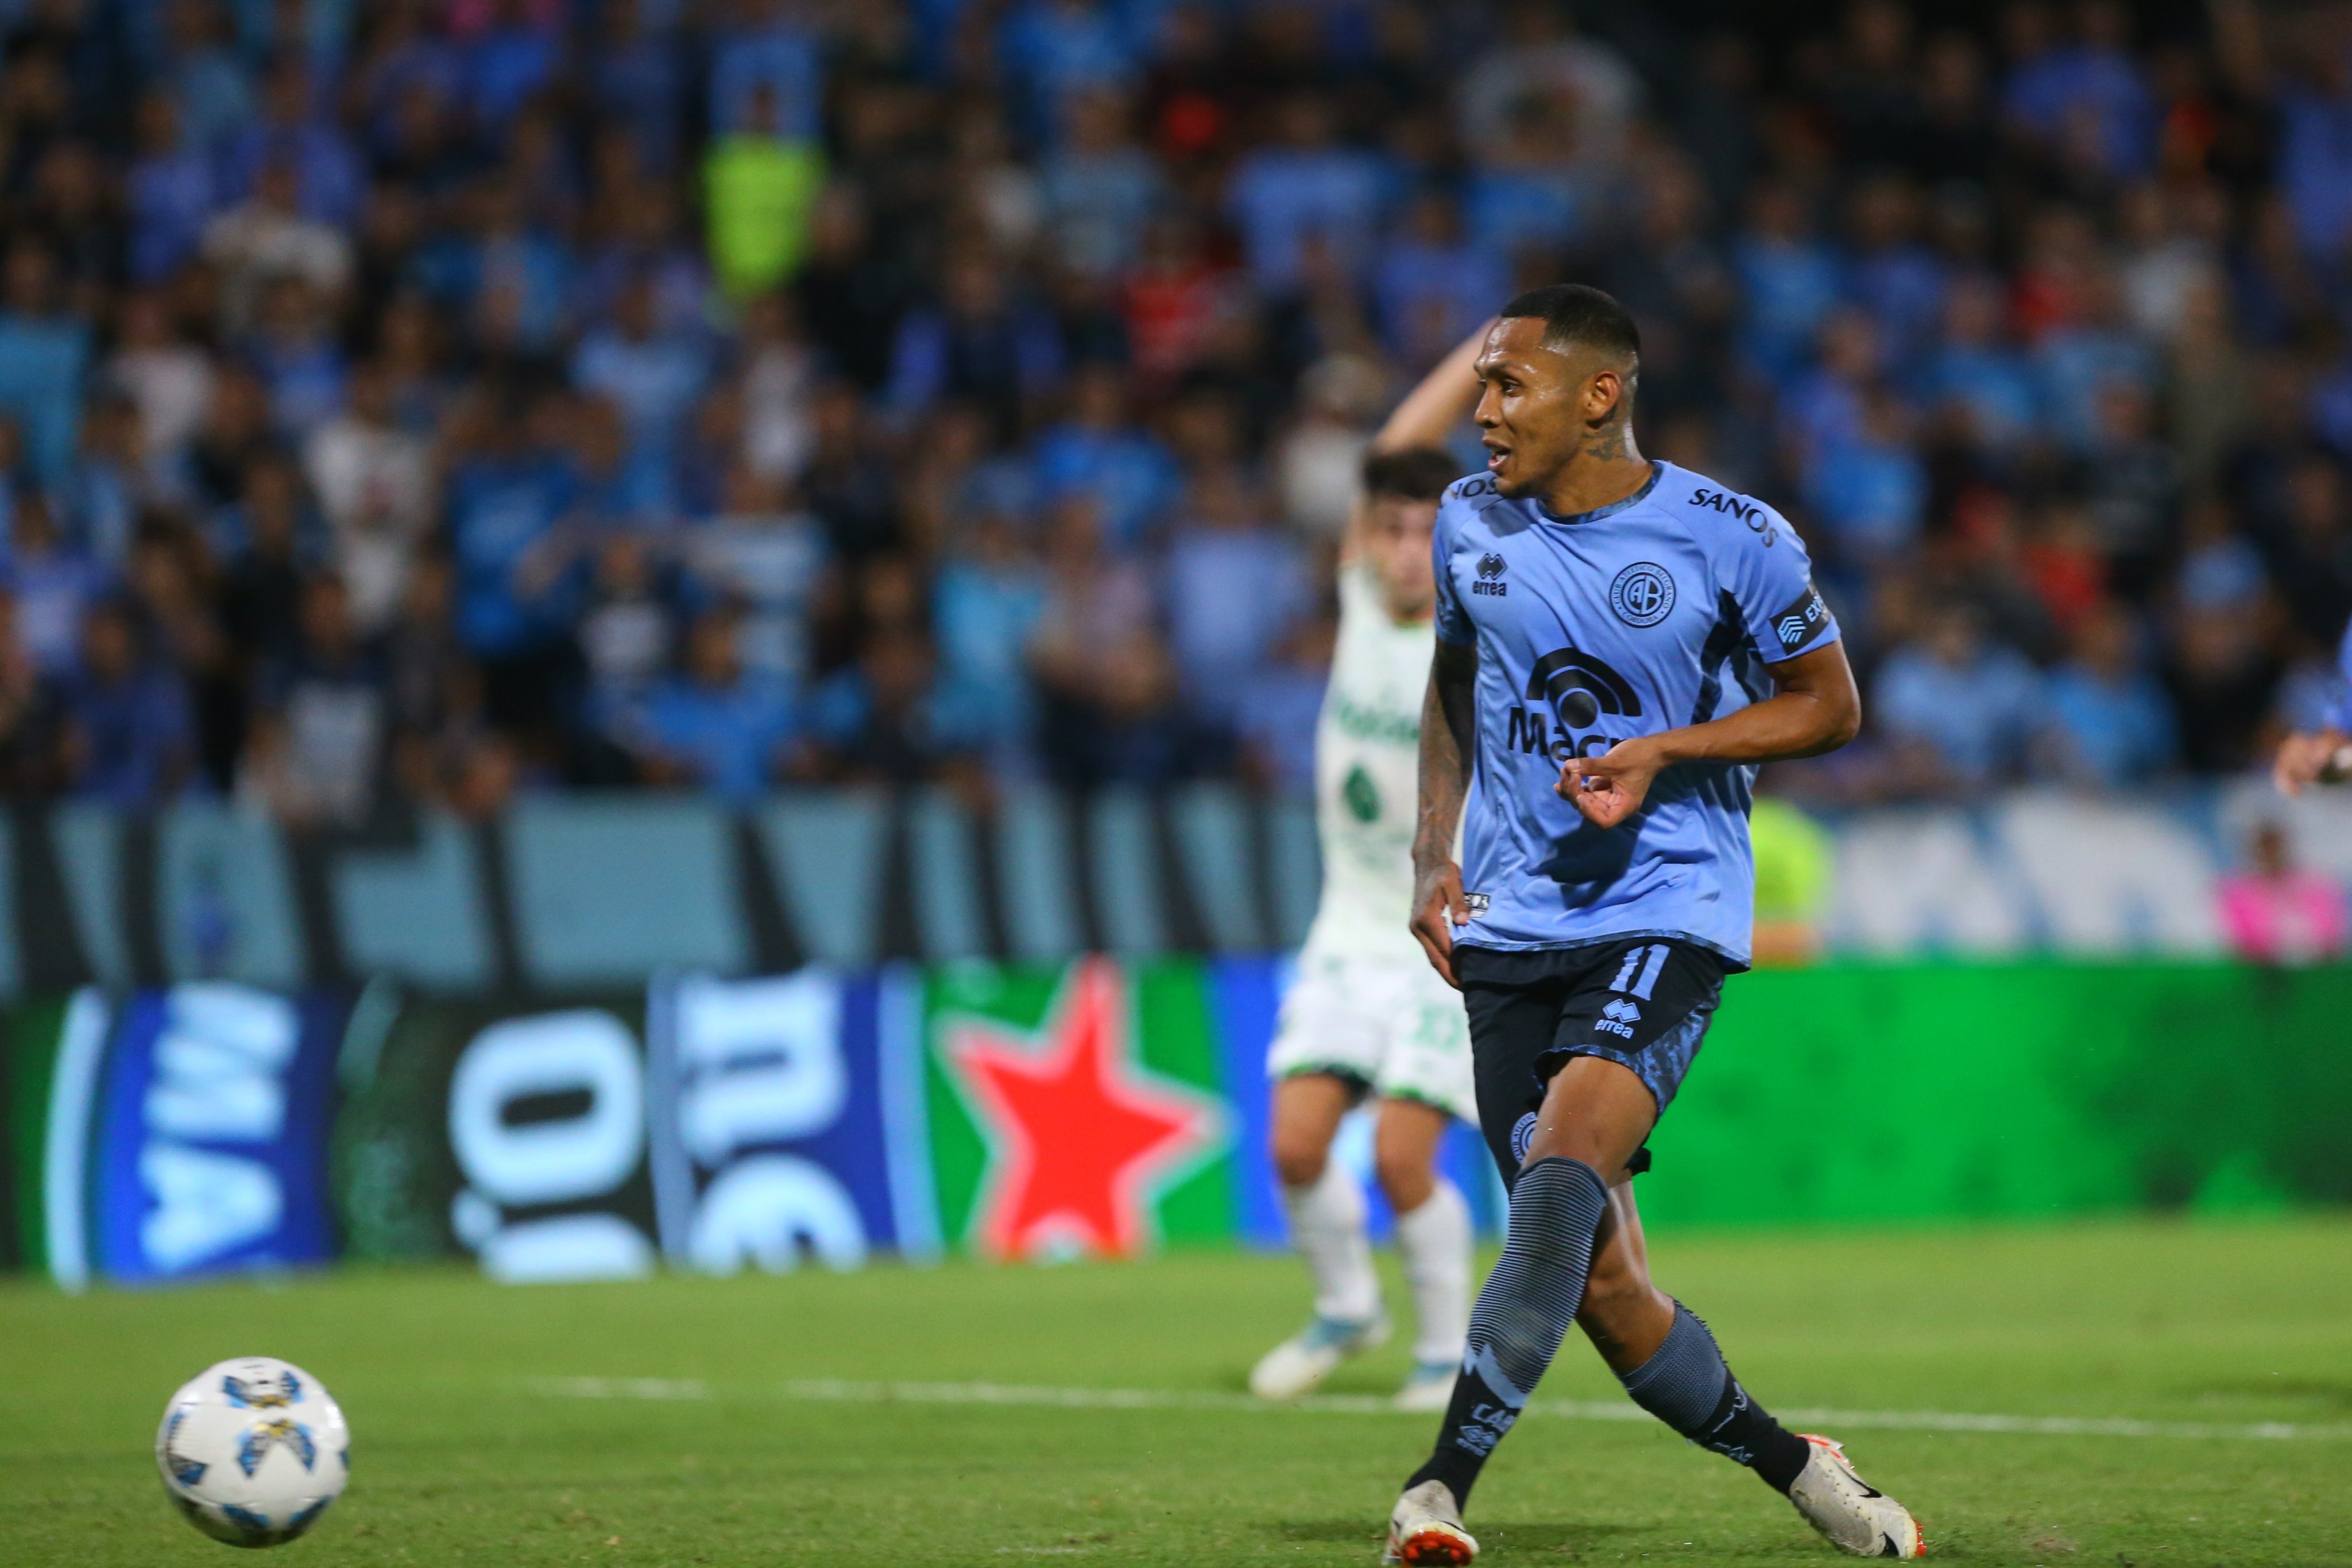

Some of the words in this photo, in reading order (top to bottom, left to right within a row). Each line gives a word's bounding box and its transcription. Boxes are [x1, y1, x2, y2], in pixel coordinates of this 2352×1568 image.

[1688, 489, 1778, 548] SANOS
[1473, 580, 1507, 596] errea
[1609, 944, 1670, 1001] 11
[1594, 1019, 1634, 1039] errea
